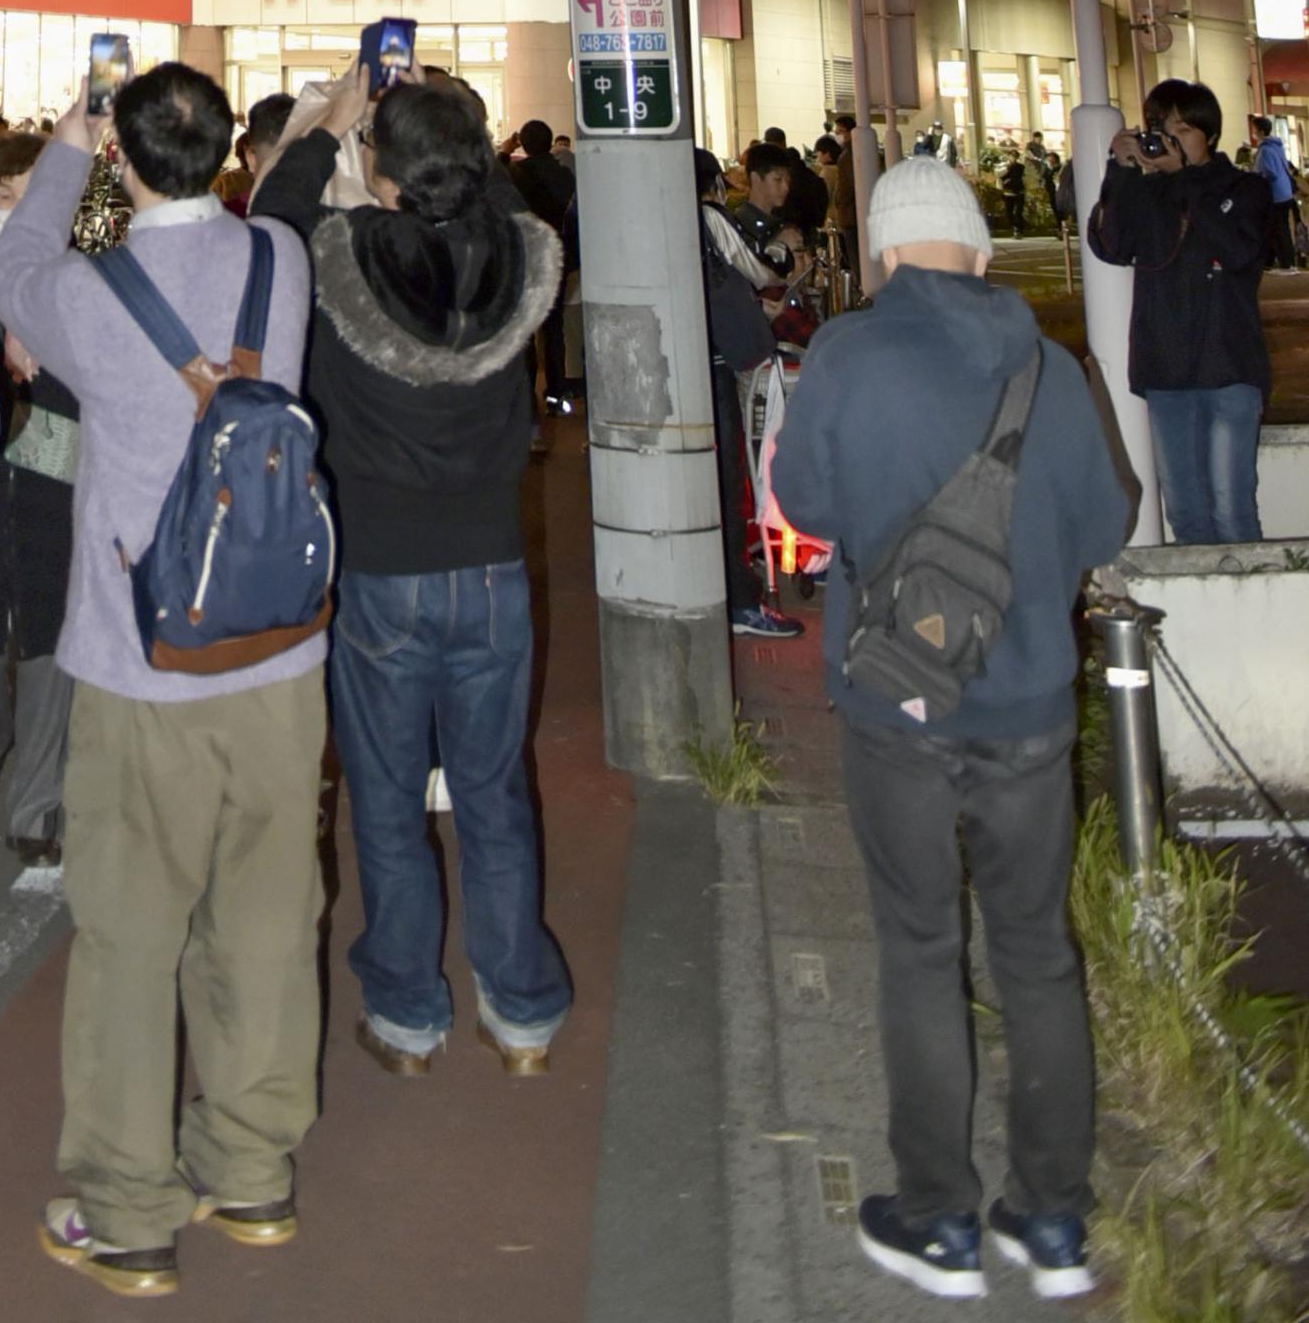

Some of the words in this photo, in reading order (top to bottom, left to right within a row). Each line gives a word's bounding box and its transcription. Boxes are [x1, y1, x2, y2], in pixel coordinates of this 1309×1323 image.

[609, 9, 665, 28] 公園前
[594, 74, 656, 95] 中央
[603, 101, 649, 122] 1-9
